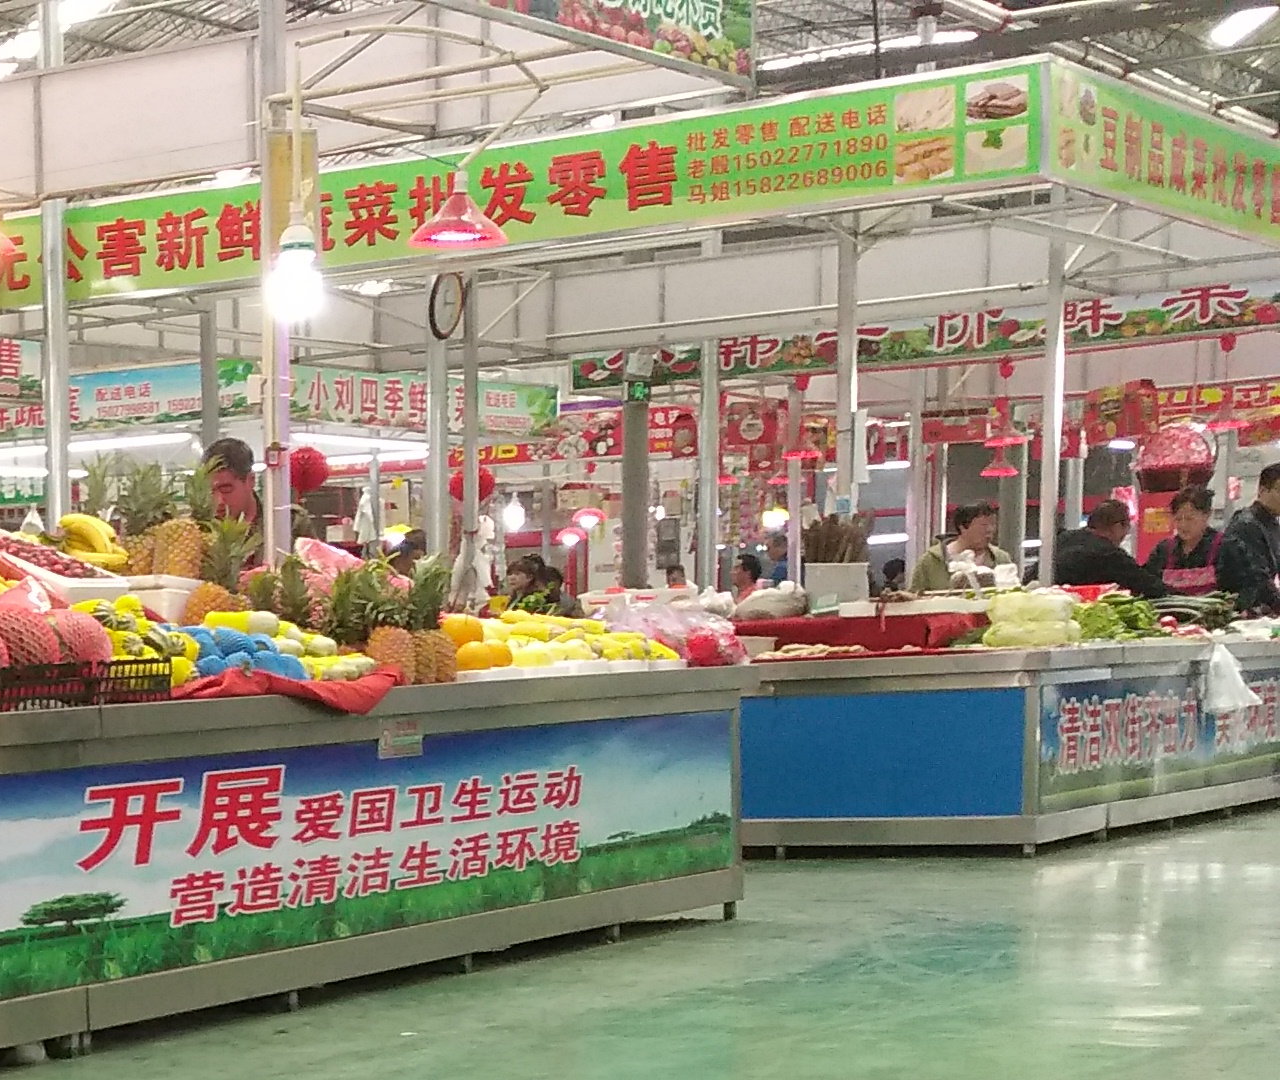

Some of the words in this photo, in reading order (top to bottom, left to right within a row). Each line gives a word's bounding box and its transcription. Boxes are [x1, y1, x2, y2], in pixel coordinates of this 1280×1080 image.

[687, 120, 779, 151] 批发零售
[790, 104, 886, 137] 配送电话
[169, 821, 583, 928] 营造清洁生活环境
